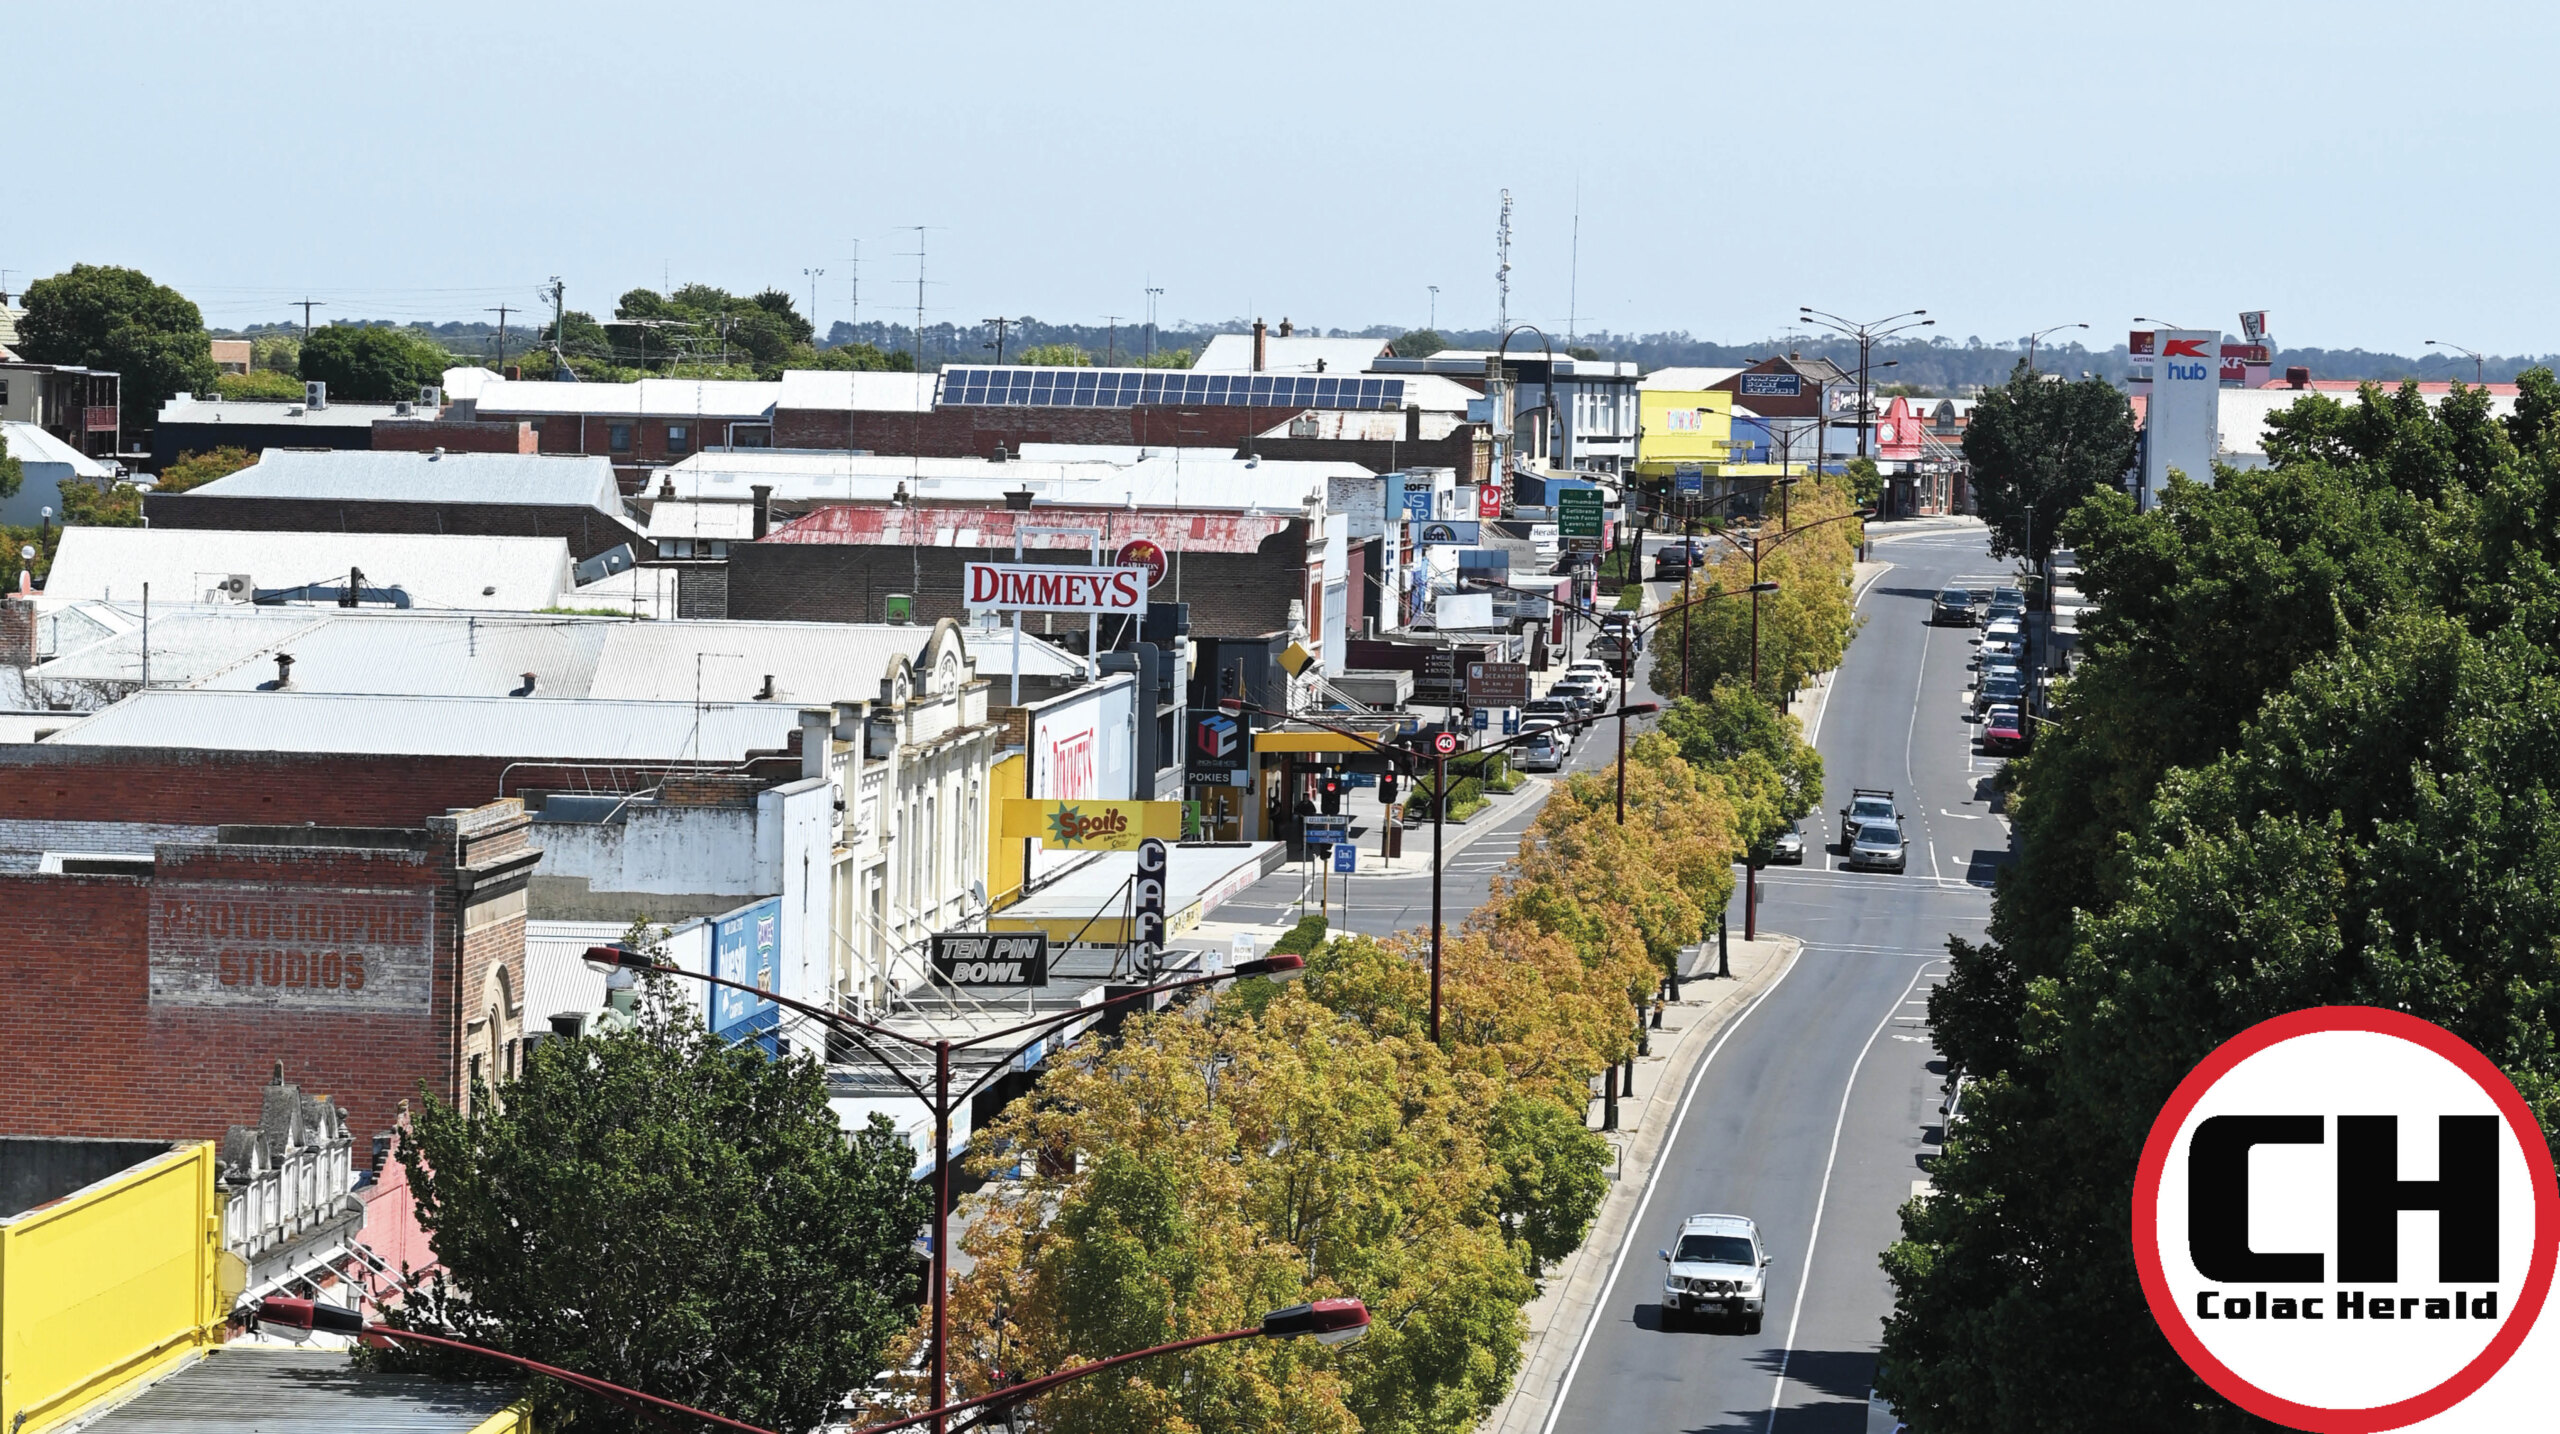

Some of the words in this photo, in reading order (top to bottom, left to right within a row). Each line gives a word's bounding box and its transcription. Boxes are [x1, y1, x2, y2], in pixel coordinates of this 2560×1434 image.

[2168, 362, 2207, 380] hub
[1533, 528, 1558, 537] Herald
[971, 566, 1139, 608] DIMMEYS
[1440, 739, 1453, 749] 40
[1189, 772, 1230, 782] POKIES
[1060, 807, 1128, 838] Spoils
[941, 939, 990, 959] TEN
[993, 939, 1039, 959] PIN
[219, 948, 365, 990] STUDIOS
[952, 962, 1025, 983] BOWL
